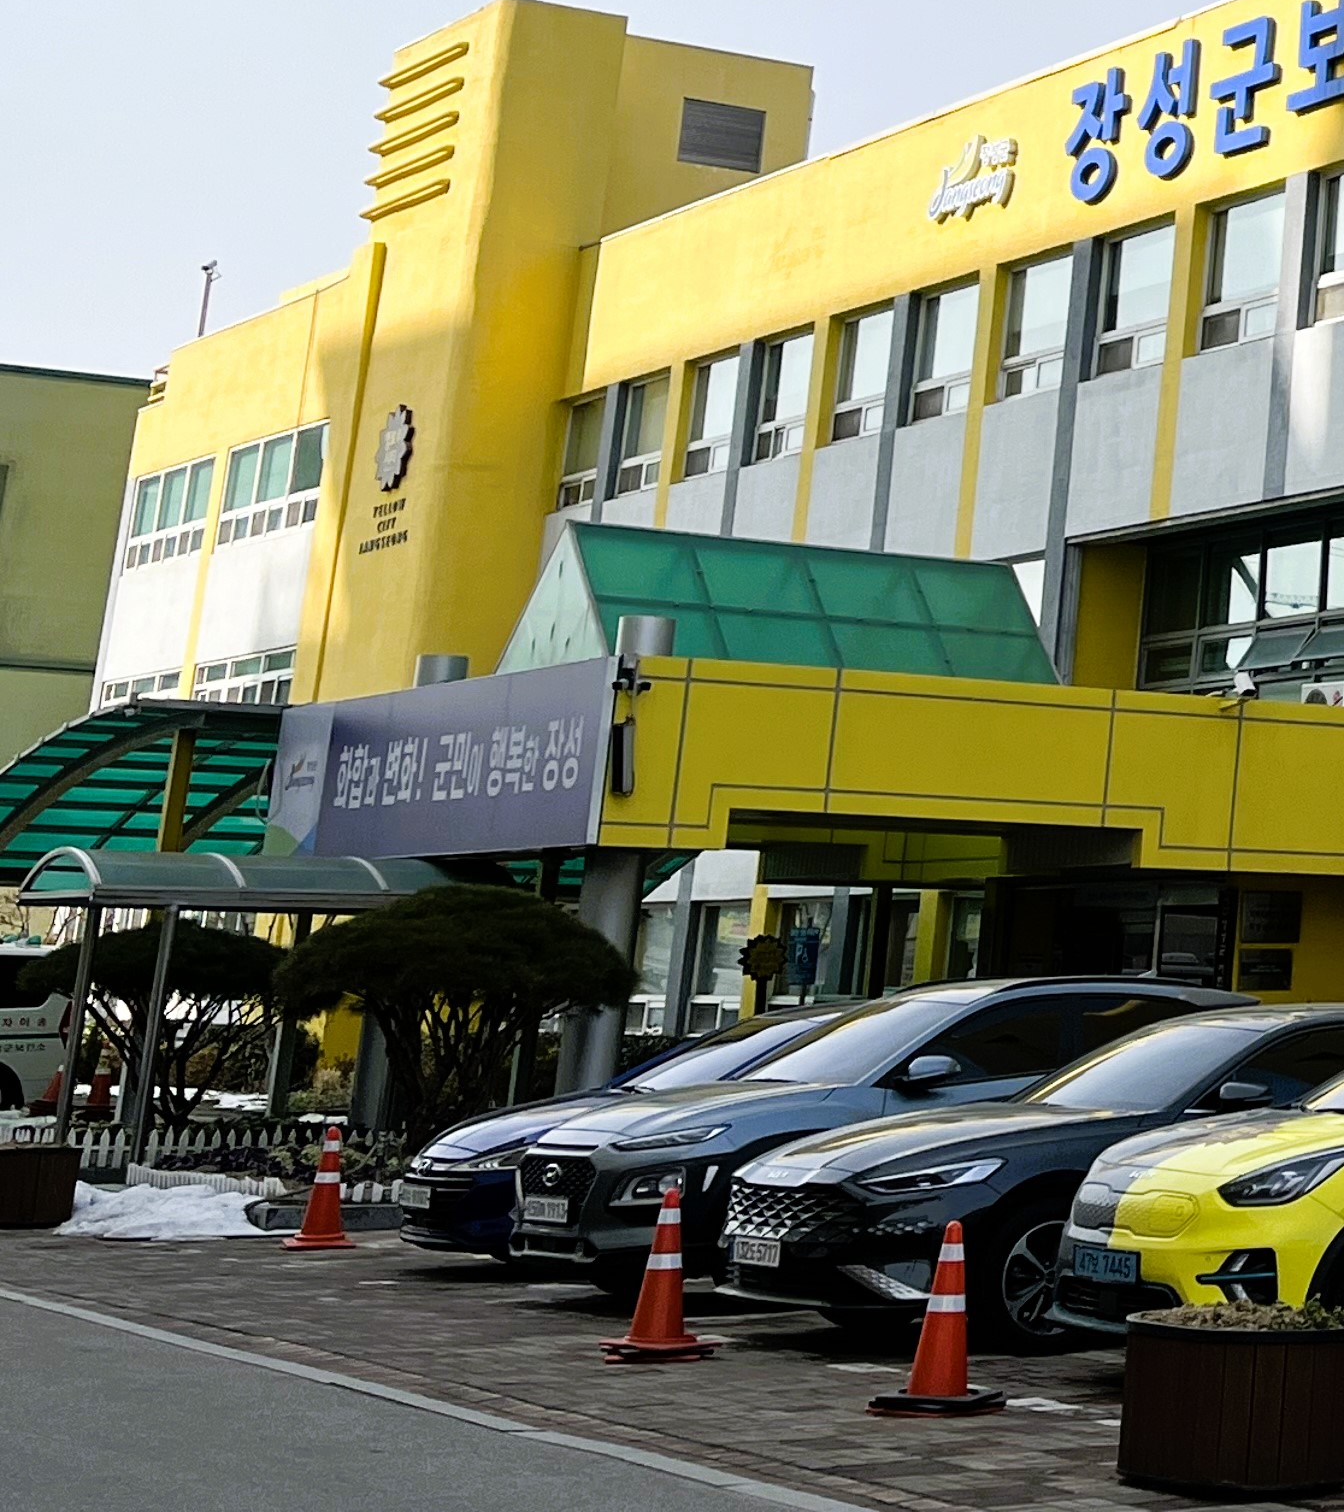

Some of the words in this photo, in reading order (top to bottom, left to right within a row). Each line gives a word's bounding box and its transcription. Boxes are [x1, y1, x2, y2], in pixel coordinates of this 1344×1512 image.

[372, 498, 407, 519] YELLOW
[376, 516, 397, 534] CITY
[332, 743, 381, 809] 화합과
[381, 736, 430, 807] 변화!
[431, 730, 485, 802] 군민이
[486, 724, 541, 797] 행복한
[542, 714, 586, 791] 장성
